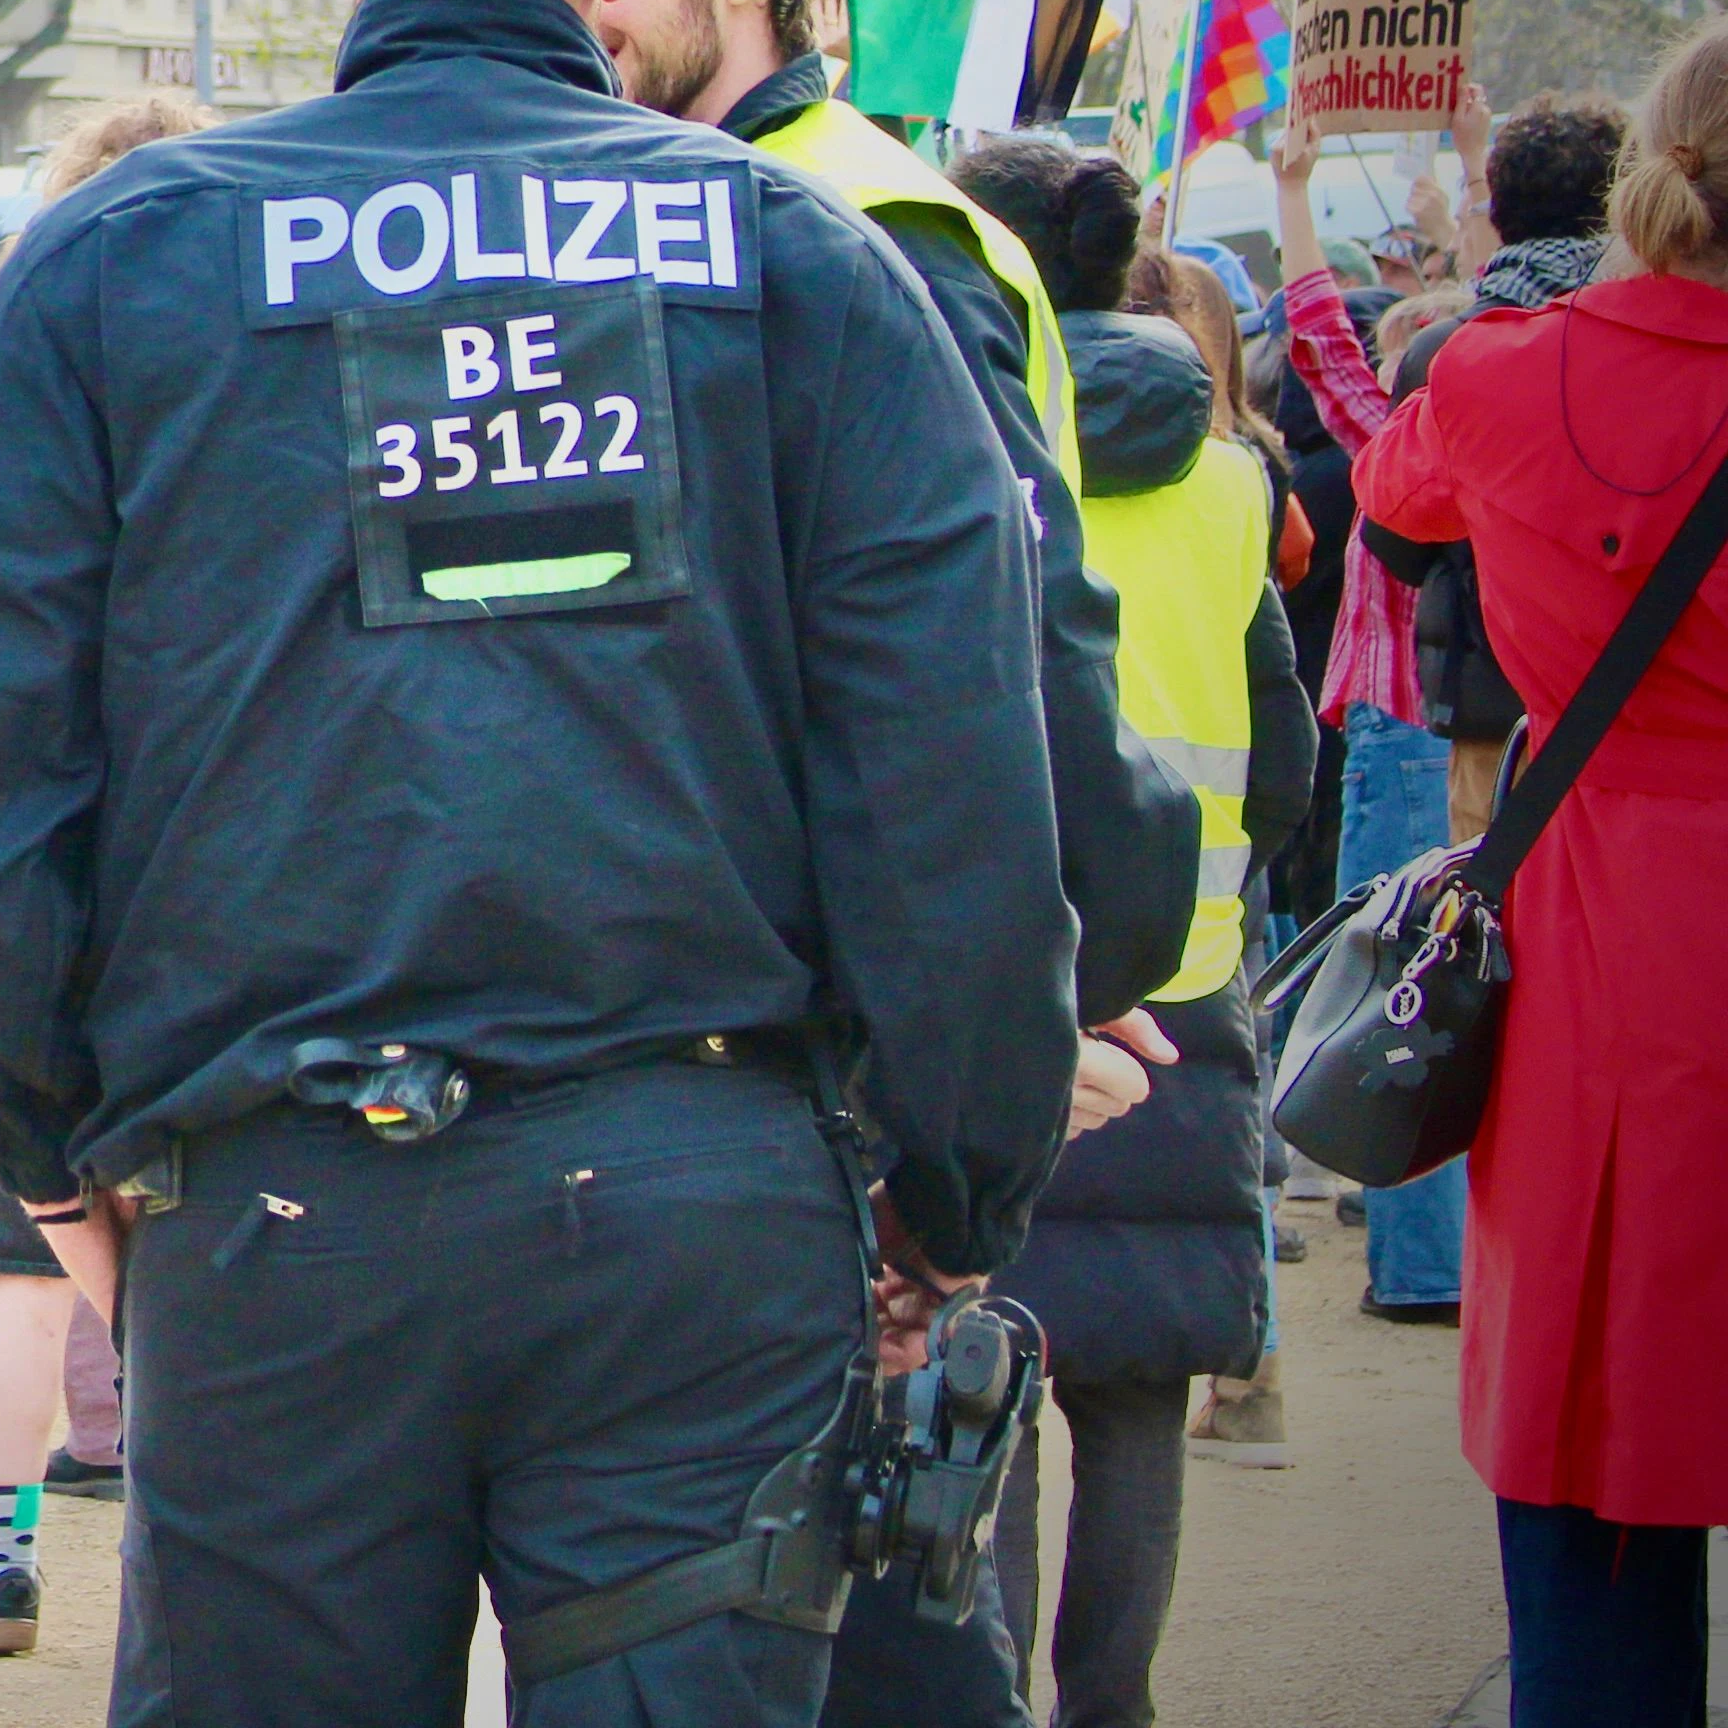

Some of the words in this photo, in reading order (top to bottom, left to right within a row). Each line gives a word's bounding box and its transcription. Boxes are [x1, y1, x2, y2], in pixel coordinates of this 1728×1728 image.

[262, 173, 739, 305] POLIZEI
[440, 314, 563, 401] BE
[375, 395, 645, 498] 35122
